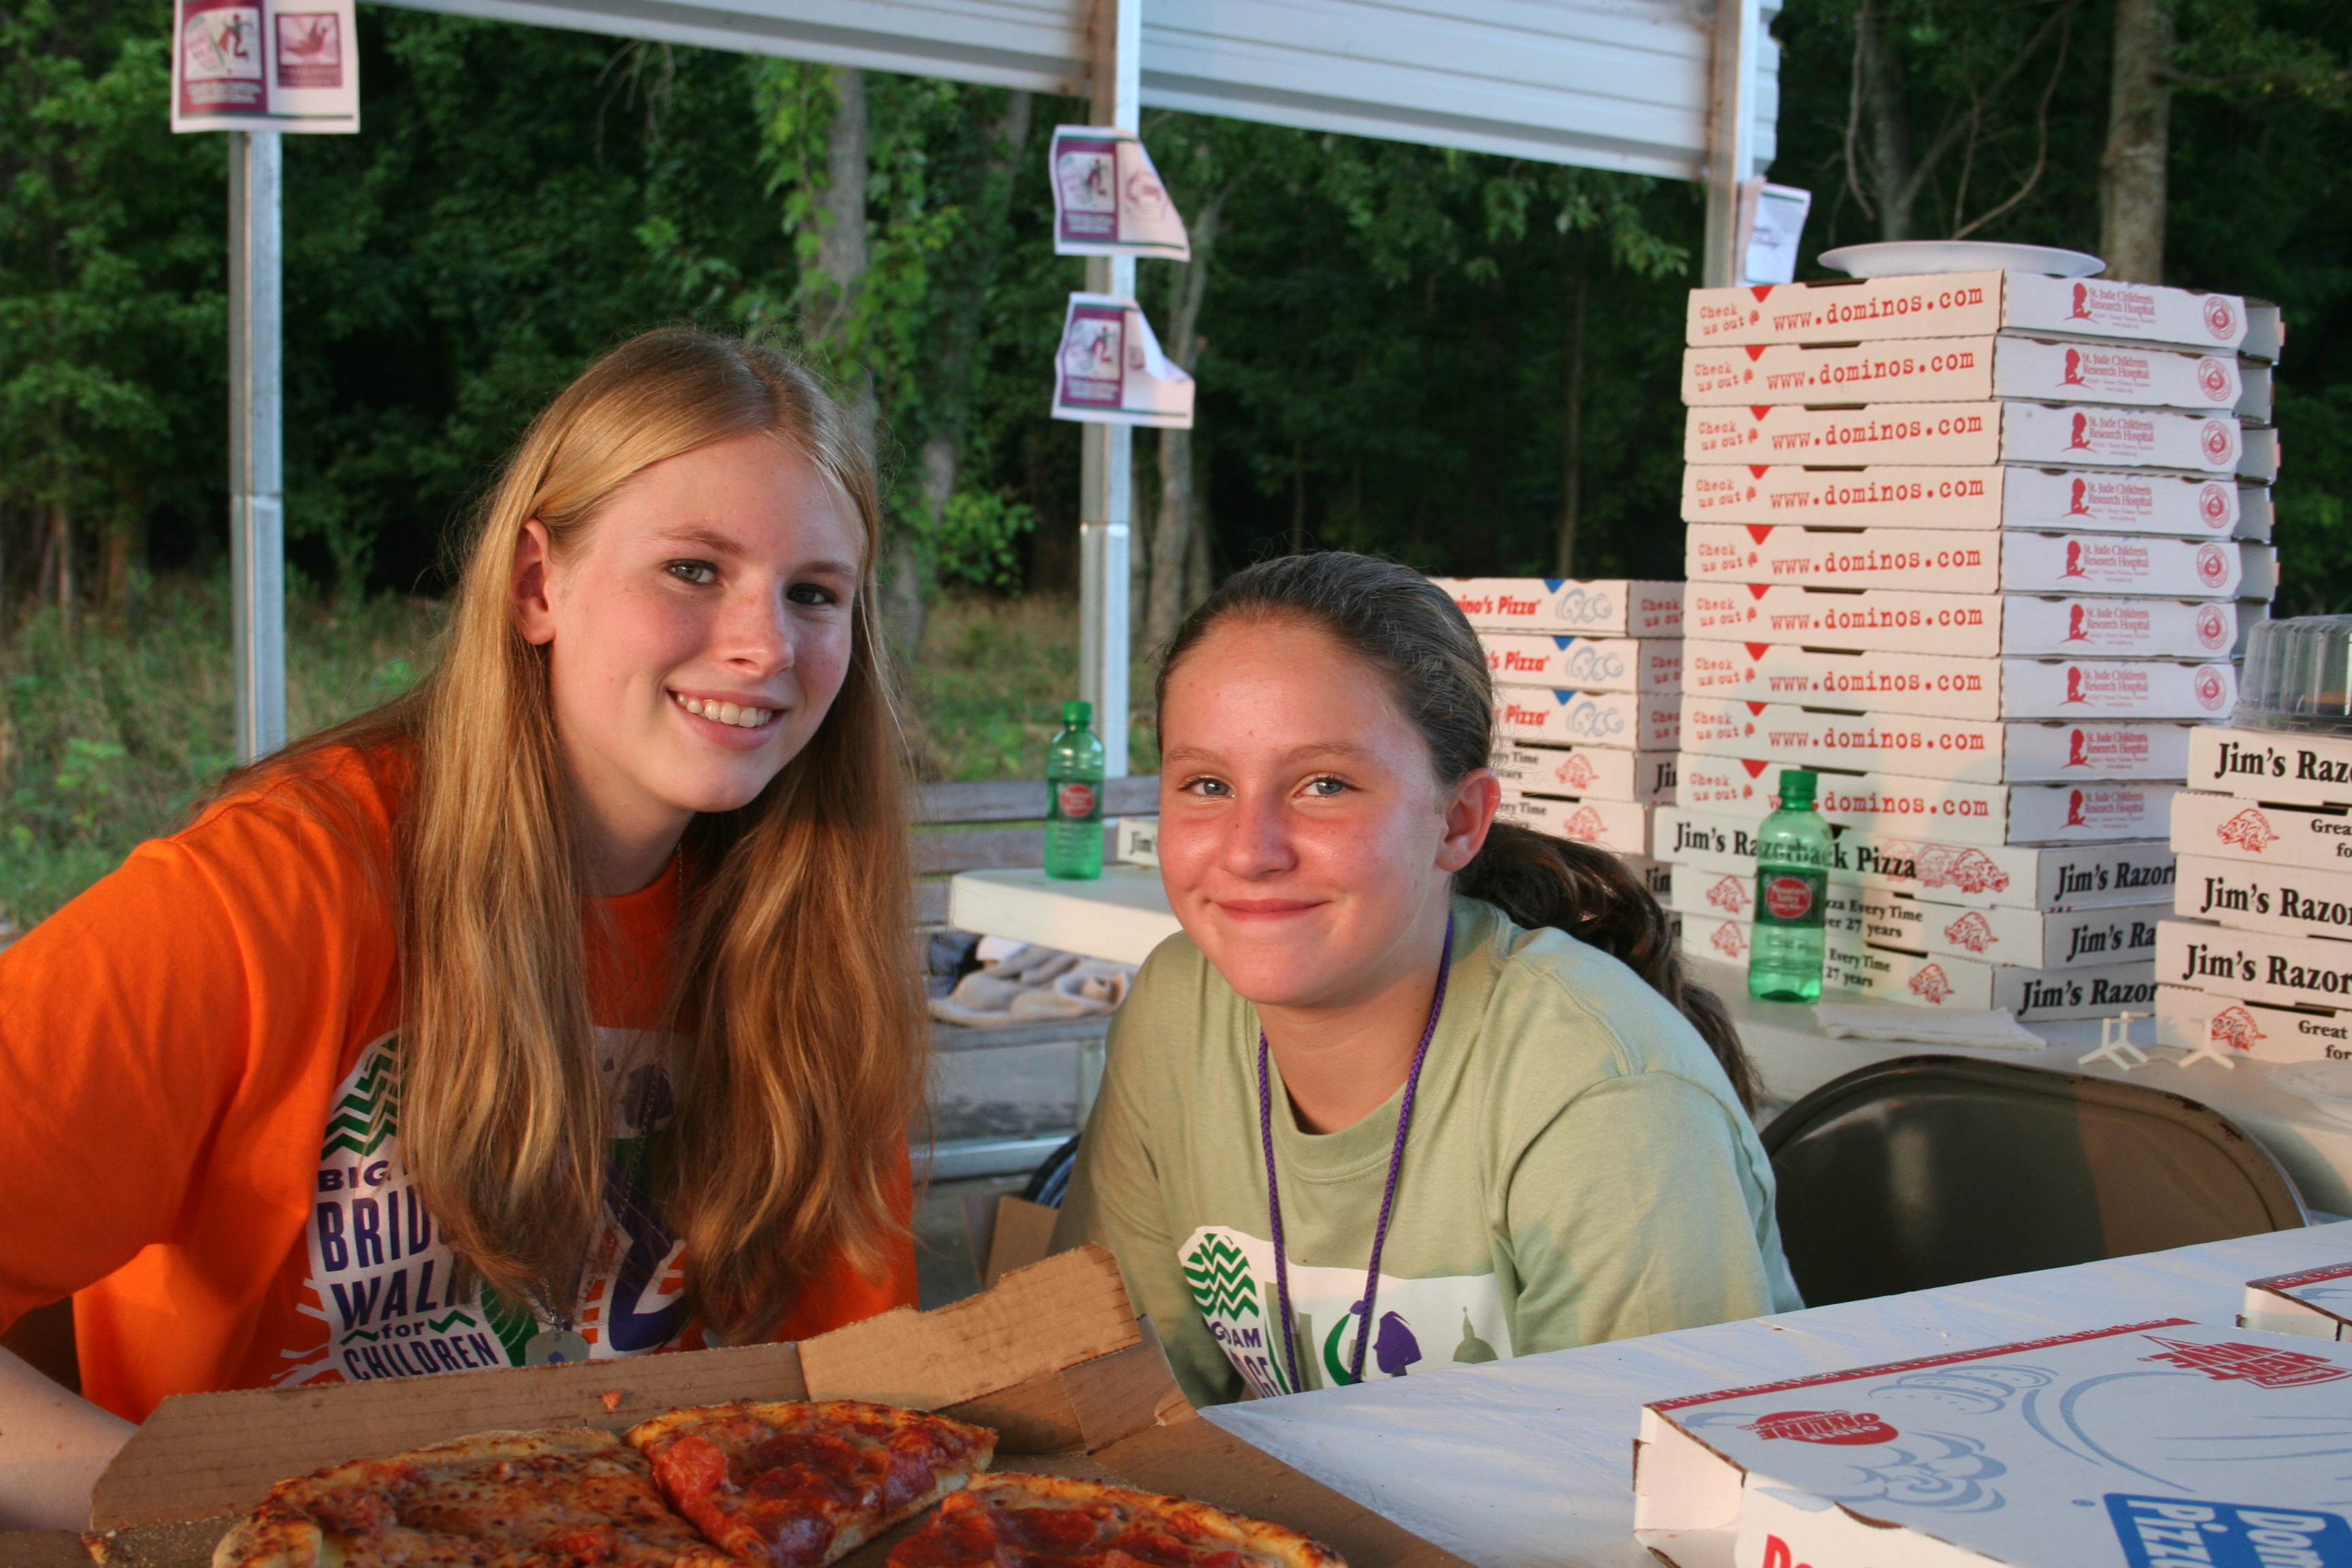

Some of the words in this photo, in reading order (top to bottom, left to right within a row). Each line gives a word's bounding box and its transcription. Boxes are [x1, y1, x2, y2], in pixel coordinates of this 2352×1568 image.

[2100, 289, 2116, 300] Jude
[1701, 304, 1737, 319] Check
[1774, 287, 1983, 332] www.dominos.com
[2090, 299, 2122, 312] Research
[2125, 303, 2155, 317] Hospital
[1703, 324, 1718, 335] us
[1724, 317, 1744, 331] out
[2095, 353, 2110, 367] Jude
[1695, 364, 1731, 377] Check
[1768, 350, 1975, 391] www.dominos.com
[2082, 364, 2115, 376] Research
[2118, 368, 2150, 381] Hospital
[1698, 381, 1712, 392] us
[1718, 376, 1738, 389] out
[1699, 422, 1736, 435] Check
[2100, 417, 2116, 429] Jude
[1772, 414, 1982, 451] www.dominos.com
[2089, 427, 2122, 439] Research
[2123, 430, 2154, 444] Hospital
[1702, 440, 1716, 451] us
[1722, 434, 1743, 447] out
[1697, 480, 1734, 492] Check
[1771, 479, 1984, 508] www.dominos.com
[2098, 483, 2115, 493] Jude
[1699, 497, 1713, 508] us
[1720, 493, 1741, 506] out
[2089, 493, 2121, 504] Research
[2122, 496, 2153, 510] Hospital
[1699, 544, 1736, 556] Check
[2095, 544, 2110, 556] Jude
[1702, 561, 1716, 572] us
[1722, 557, 1743, 571] out
[1772, 549, 1981, 575] www.dominos.com
[2084, 555, 2117, 566] Research
[2119, 557, 2149, 570] Hospital
[1498, 595, 1537, 615] Pizza
[1642, 599, 1680, 611] Check
[1697, 598, 1734, 610] Check
[1700, 616, 1714, 627] us
[1720, 612, 1742, 625] out
[1771, 608, 1984, 630] www.dominos.com
[2097, 607, 2113, 619] Jude
[2087, 619, 2119, 630] Research
[2121, 619, 2150, 632] Hospital
[1505, 651, 1546, 672] Pizza
[1695, 658, 1733, 671] Check
[1699, 675, 1712, 686] us
[1720, 671, 1740, 685] out
[1769, 672, 1982, 691] www.dominos.com
[2095, 670, 2110, 681] Jude
[2085, 681, 2117, 691] Research
[2119, 681, 2149, 694] Hospital
[1505, 705, 1546, 725] Pizza
[1694, 712, 1731, 725] Check
[1697, 729, 1712, 740] us
[1718, 725, 1740, 738] out
[1769, 728, 1984, 749] www.dominos.com
[1512, 751, 1538, 764] Time
[2214, 742, 2286, 779] Jim's
[2296, 750, 2352, 783] Raz
[1690, 773, 1729, 787] Check
[1694, 790, 1708, 802] us
[1715, 788, 1737, 800] out
[1520, 802, 1546, 815] Time
[1768, 792, 1989, 816] w.dominos.com
[1674, 822, 1725, 852] Jim's
[1857, 846, 1916, 879] Pizza
[2054, 864, 2108, 902] Jim's
[2200, 877, 2270, 914] Jim's
[1850, 900, 1886, 919] Every
[1889, 905, 1923, 921] Time
[1846, 918, 1862, 932] 27
[1867, 924, 1902, 937] years
[2066, 924, 2122, 962] Jim's
[1830, 949, 1860, 969] Every
[1863, 955, 1891, 973] Time
[2182, 944, 2256, 981] Jim's
[1826, 967, 1840, 980] 27
[1844, 973, 1873, 987] years
[2018, 981, 2082, 1016] Jim's
[2298, 1020, 2348, 1039] Great
[2325, 1045, 2352, 1060] for
[318, 1160, 391, 1192] BIG
[317, 1185, 446, 1273] BRID
[380, 1320, 425, 1339] for
[343, 1332, 500, 1382] CHILDREN
[2149, 1341, 2285, 1369] WAVE
[2196, 1350, 2333, 1380] HEAT
[1756, 1411, 1880, 1440] ONLINE
[1808, 1425, 1880, 1440] ORDER
